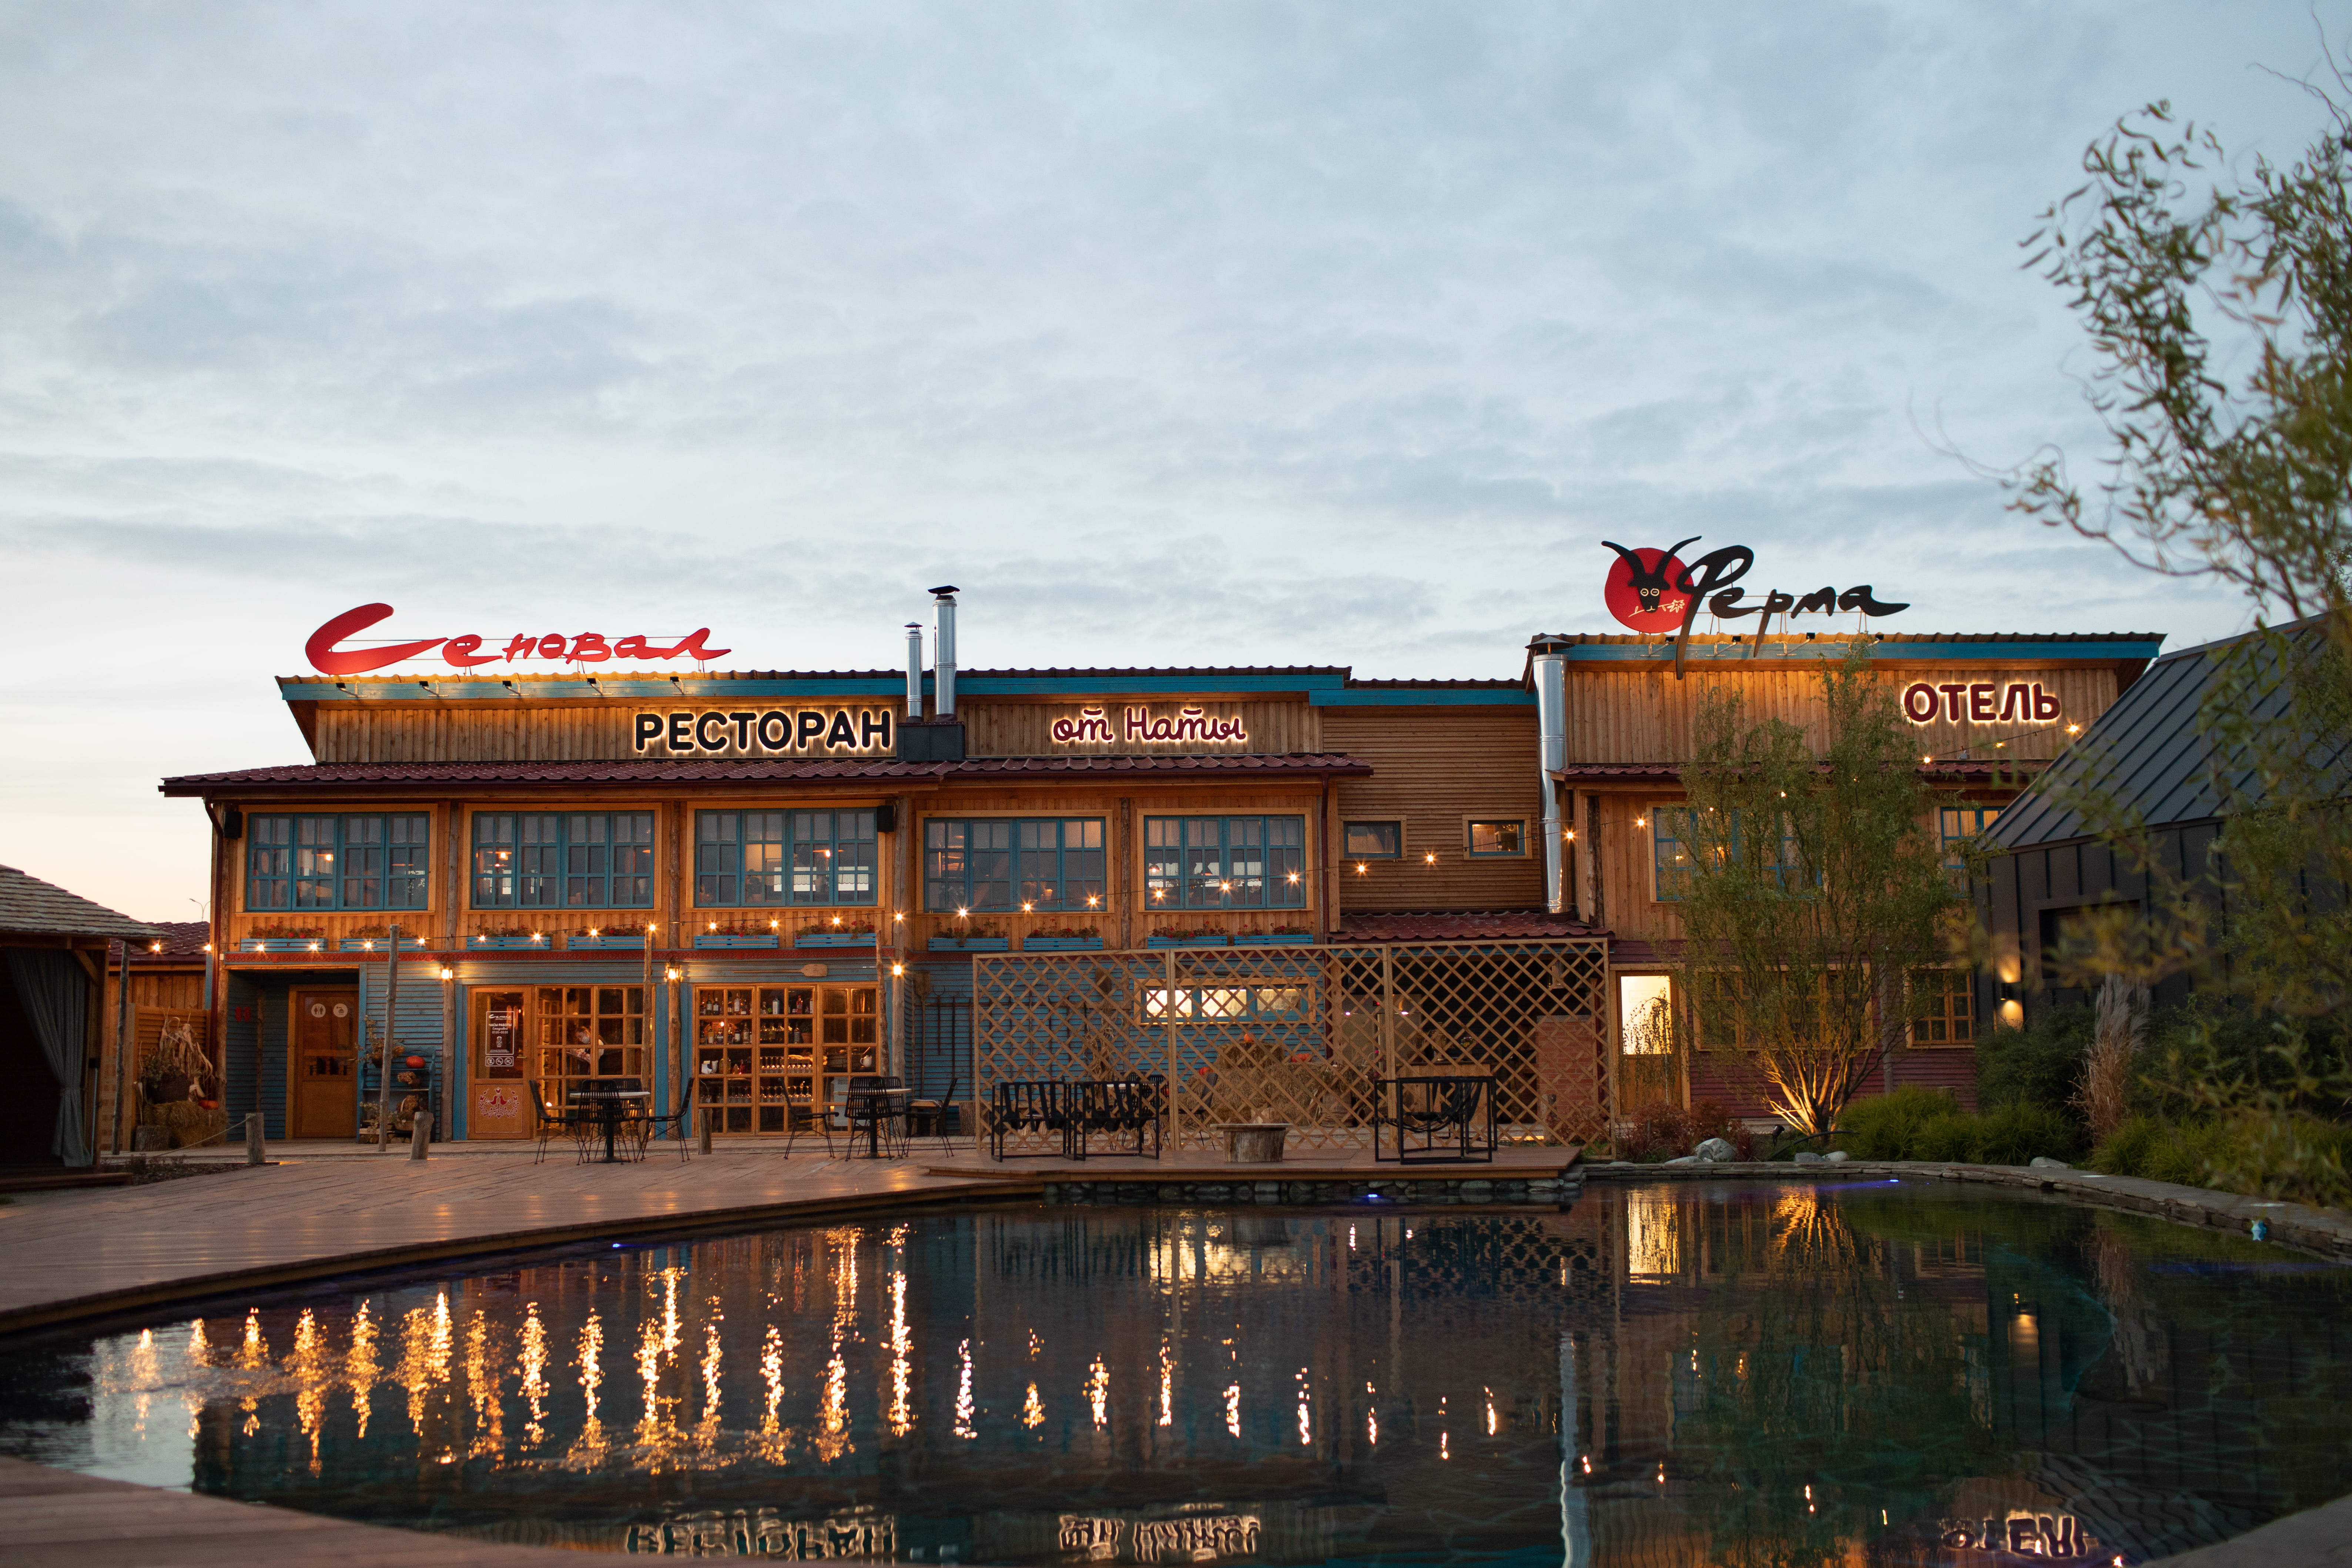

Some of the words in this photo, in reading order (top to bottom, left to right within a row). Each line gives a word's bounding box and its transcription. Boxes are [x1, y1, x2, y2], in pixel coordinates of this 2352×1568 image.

[305, 603, 732, 675] Сеновал
[1903, 683, 2061, 722] ОТЕЛЬ
[636, 710, 891, 751] РЕСТОРАН
